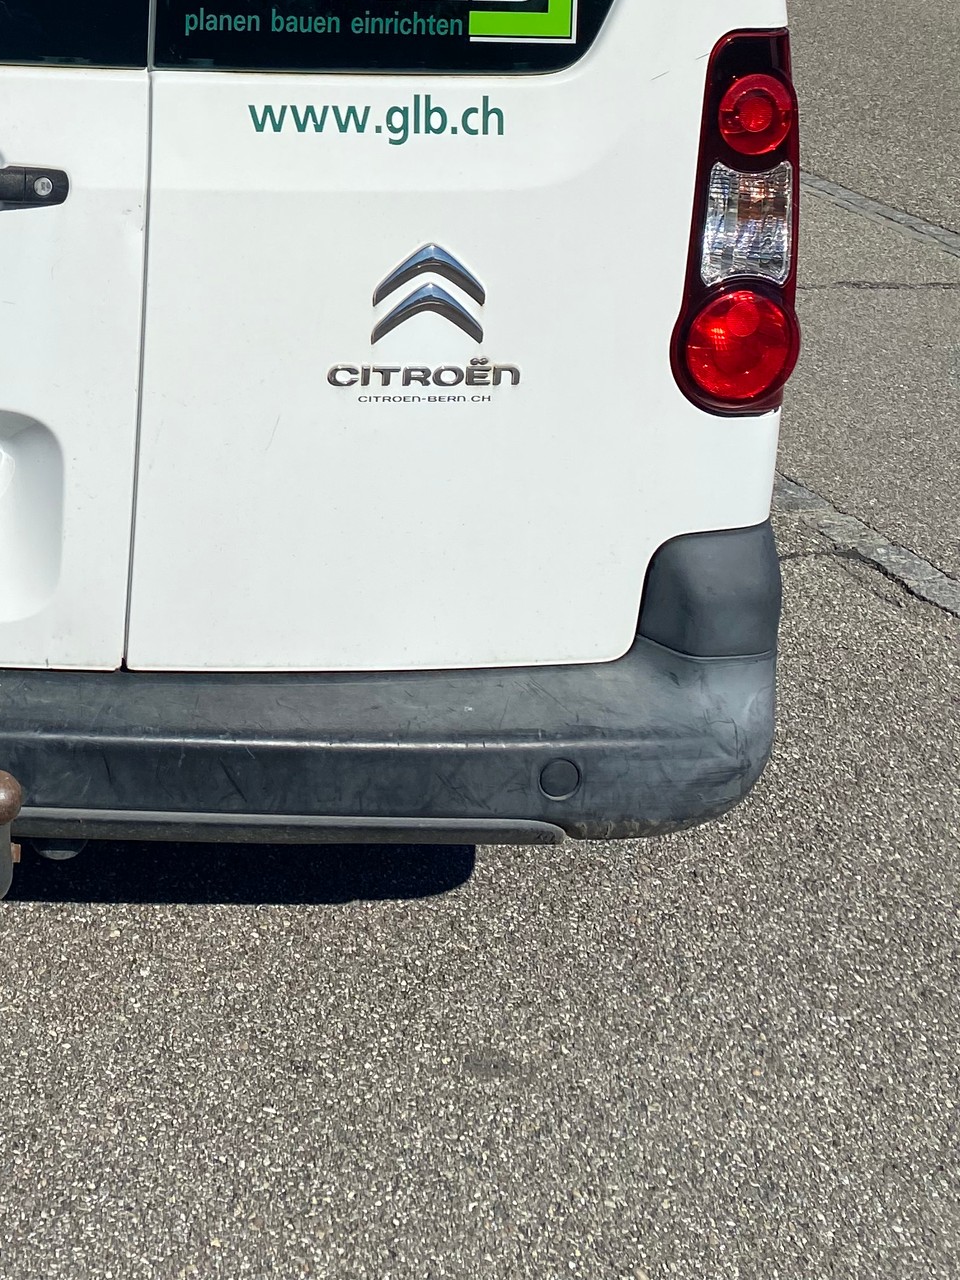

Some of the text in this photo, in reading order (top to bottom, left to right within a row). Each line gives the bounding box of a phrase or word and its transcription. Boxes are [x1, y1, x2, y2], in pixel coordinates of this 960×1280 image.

[184, 7, 463, 36] planen bauen einrichten
[248, 94, 504, 145] www.glb.ch
